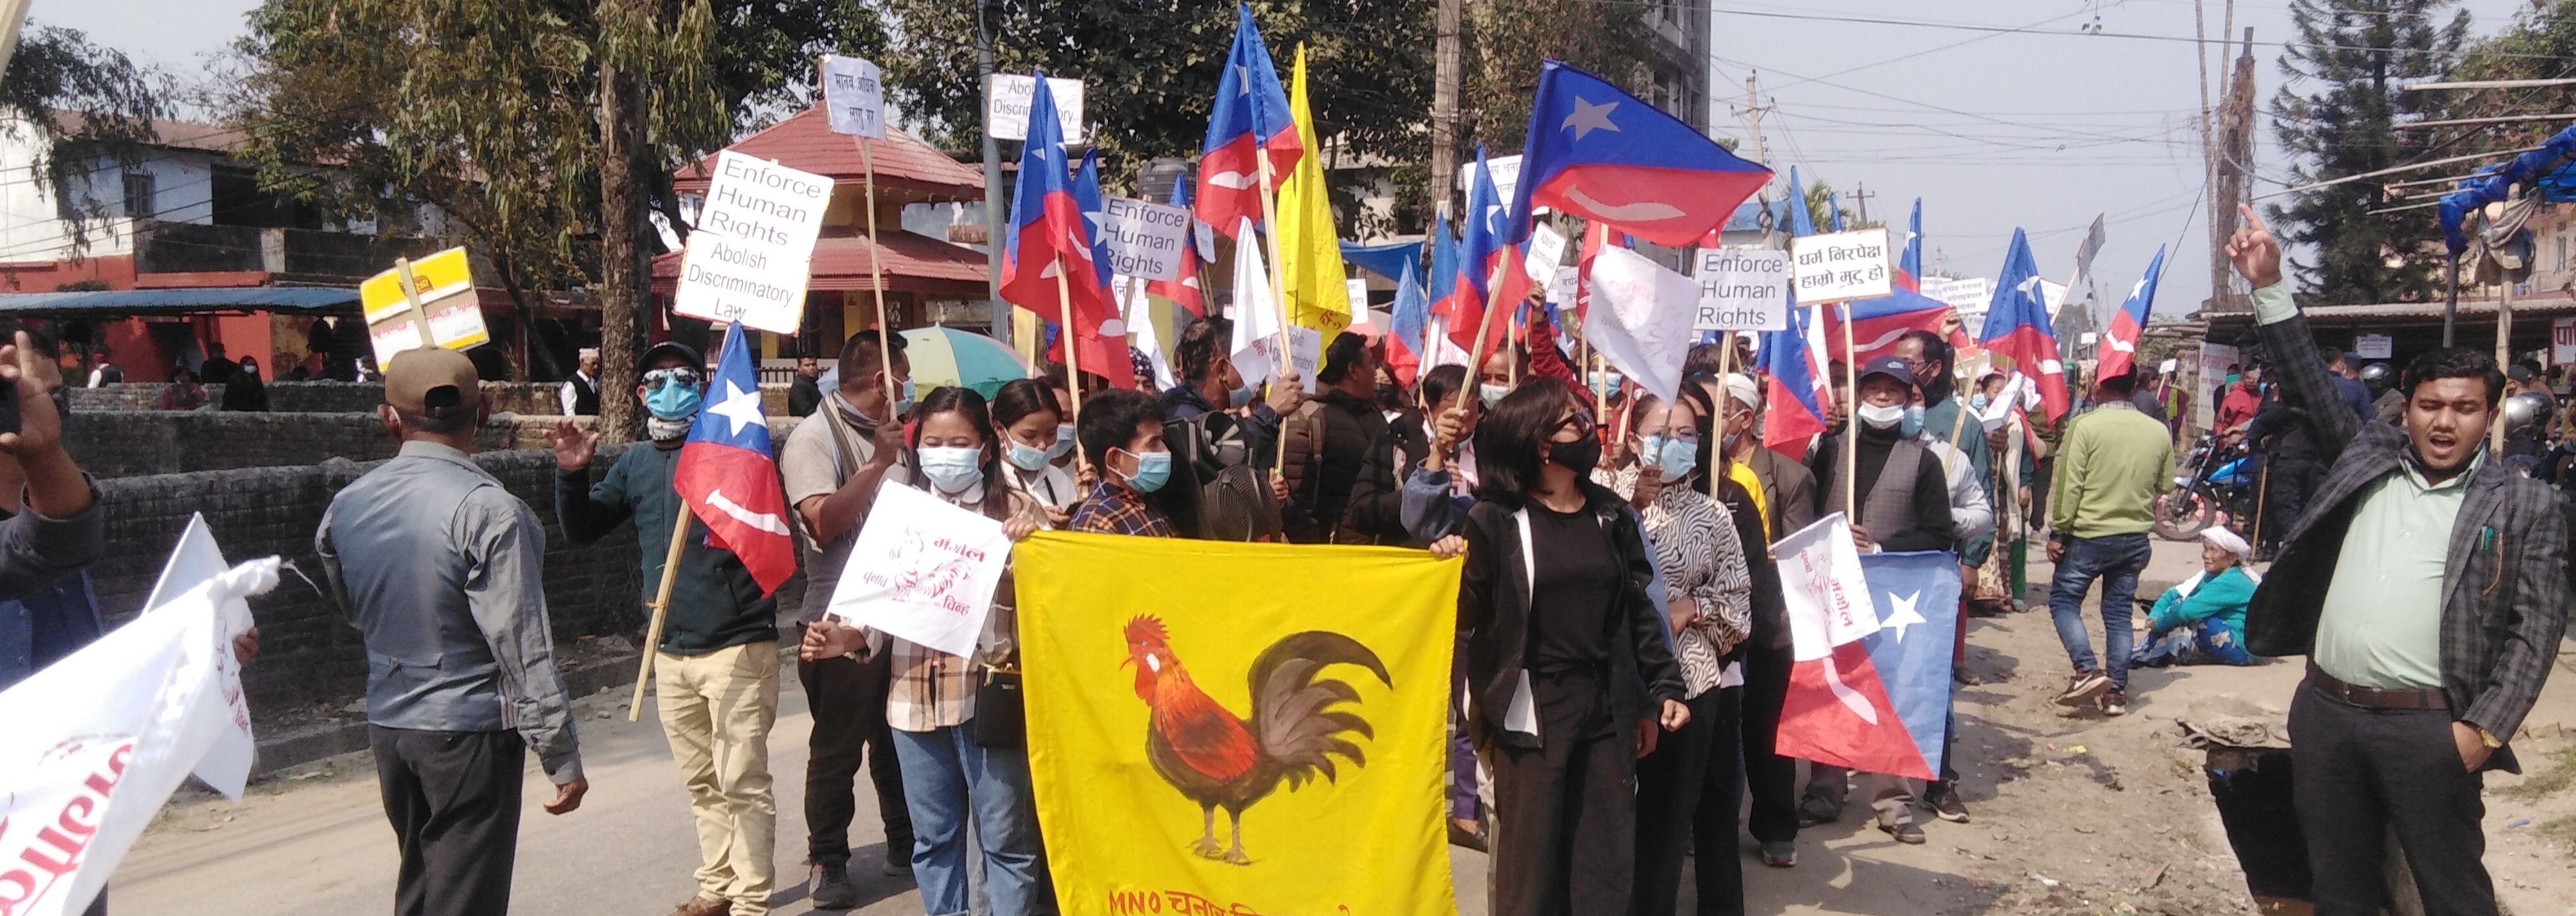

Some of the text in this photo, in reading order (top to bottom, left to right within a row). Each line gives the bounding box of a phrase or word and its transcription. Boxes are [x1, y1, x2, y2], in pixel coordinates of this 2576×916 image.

[834, 73, 854, 90] मानव
[1008, 80, 1035, 95] Abol
[993, 99, 1074, 125] Discriory
[724, 158, 821, 198] Enforce
[717, 184, 807, 223] Human
[1107, 199, 1184, 228] Enforce
[710, 210, 788, 246] Rights
[1105, 222, 1175, 251] Human
[711, 242, 766, 270] Abolish
[1107, 248, 1163, 274] Rights
[1704, 254, 1782, 272] Enforce
[1799, 244, 1881, 266] धर्म निरपेक्ष
[688, 263, 794, 308] Discriminatory
[1702, 280, 1776, 299] Human
[1801, 264, 1884, 289] हाम्रो मुटु हो
[714, 298, 746, 320] Law
[1699, 307, 1766, 327] Rights
[1109, 889, 1161, 916] MNO
